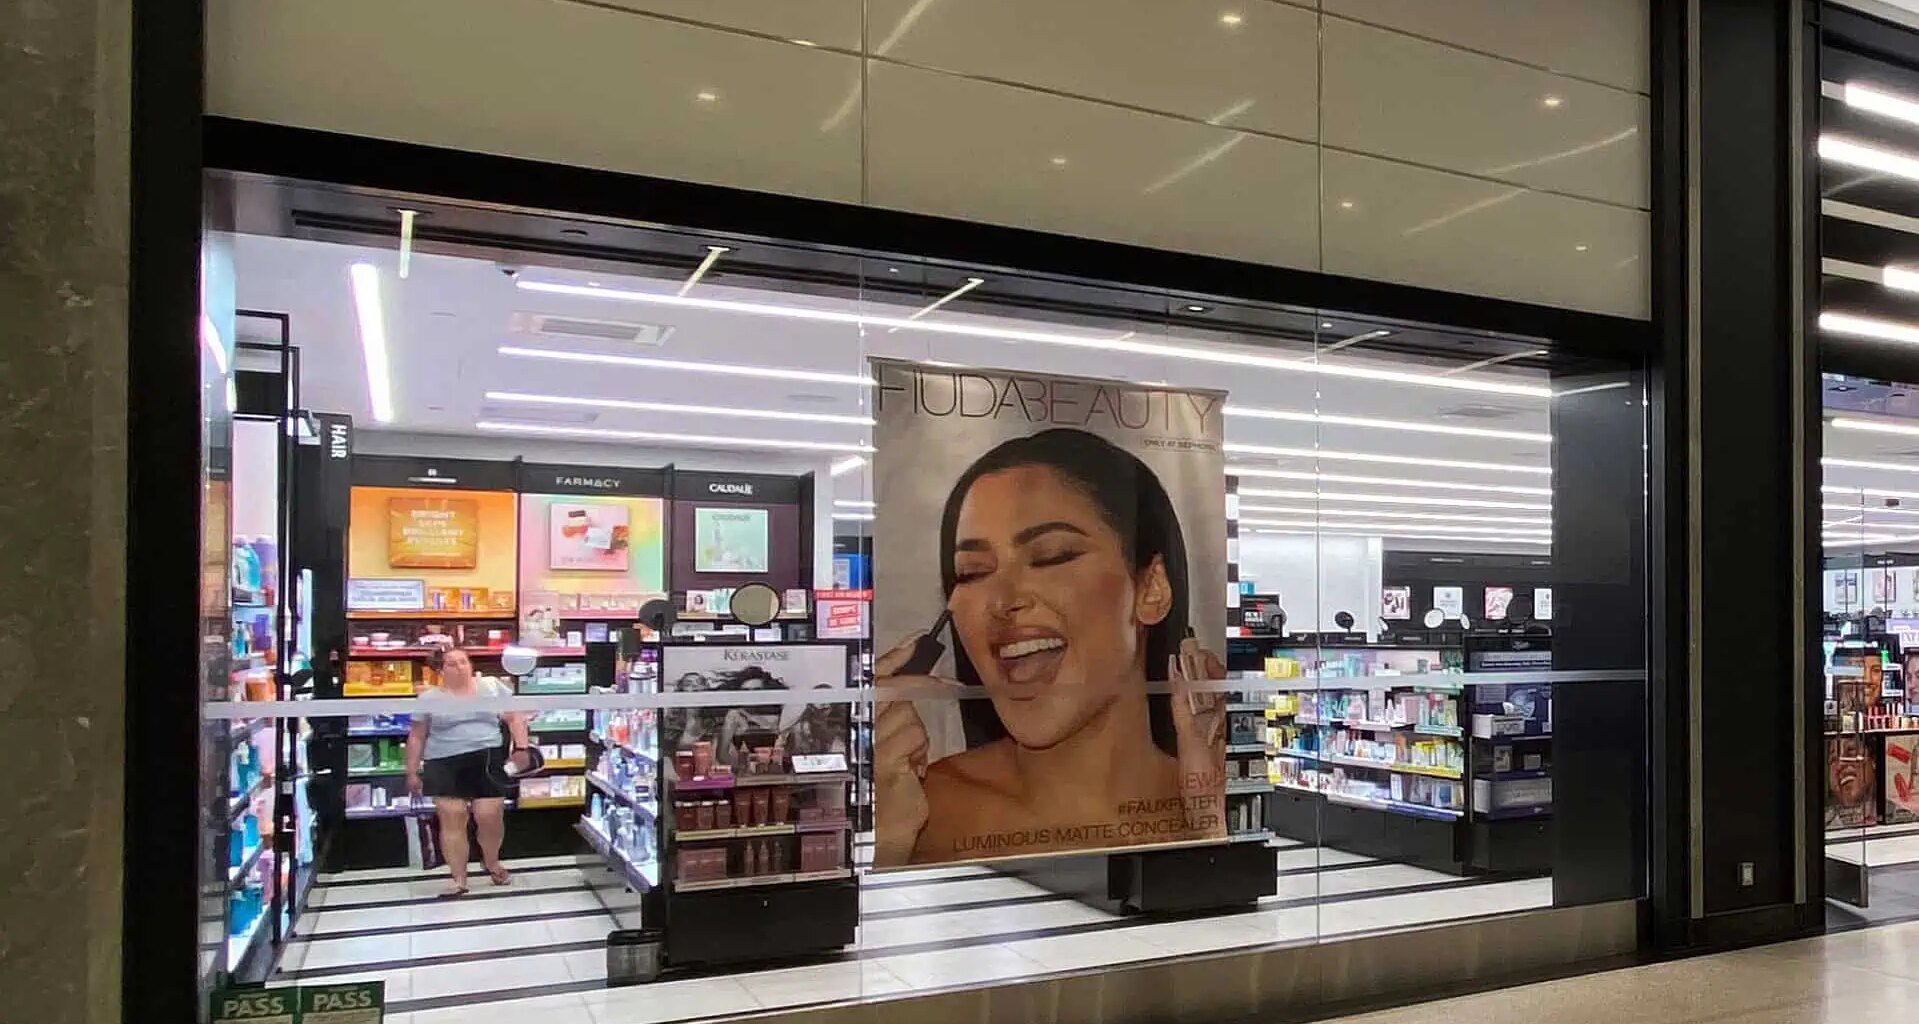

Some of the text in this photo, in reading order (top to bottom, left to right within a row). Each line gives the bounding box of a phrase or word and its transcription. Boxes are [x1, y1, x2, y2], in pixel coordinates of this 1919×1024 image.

[331, 424, 347, 458] HAIR
[556, 476, 620, 489] FARMACY
[952, 814, 1218, 852] LUMINOUS MATTE CONCEALER
[224, 997, 284, 1017] PASS
[314, 991, 372, 1010] PASS
